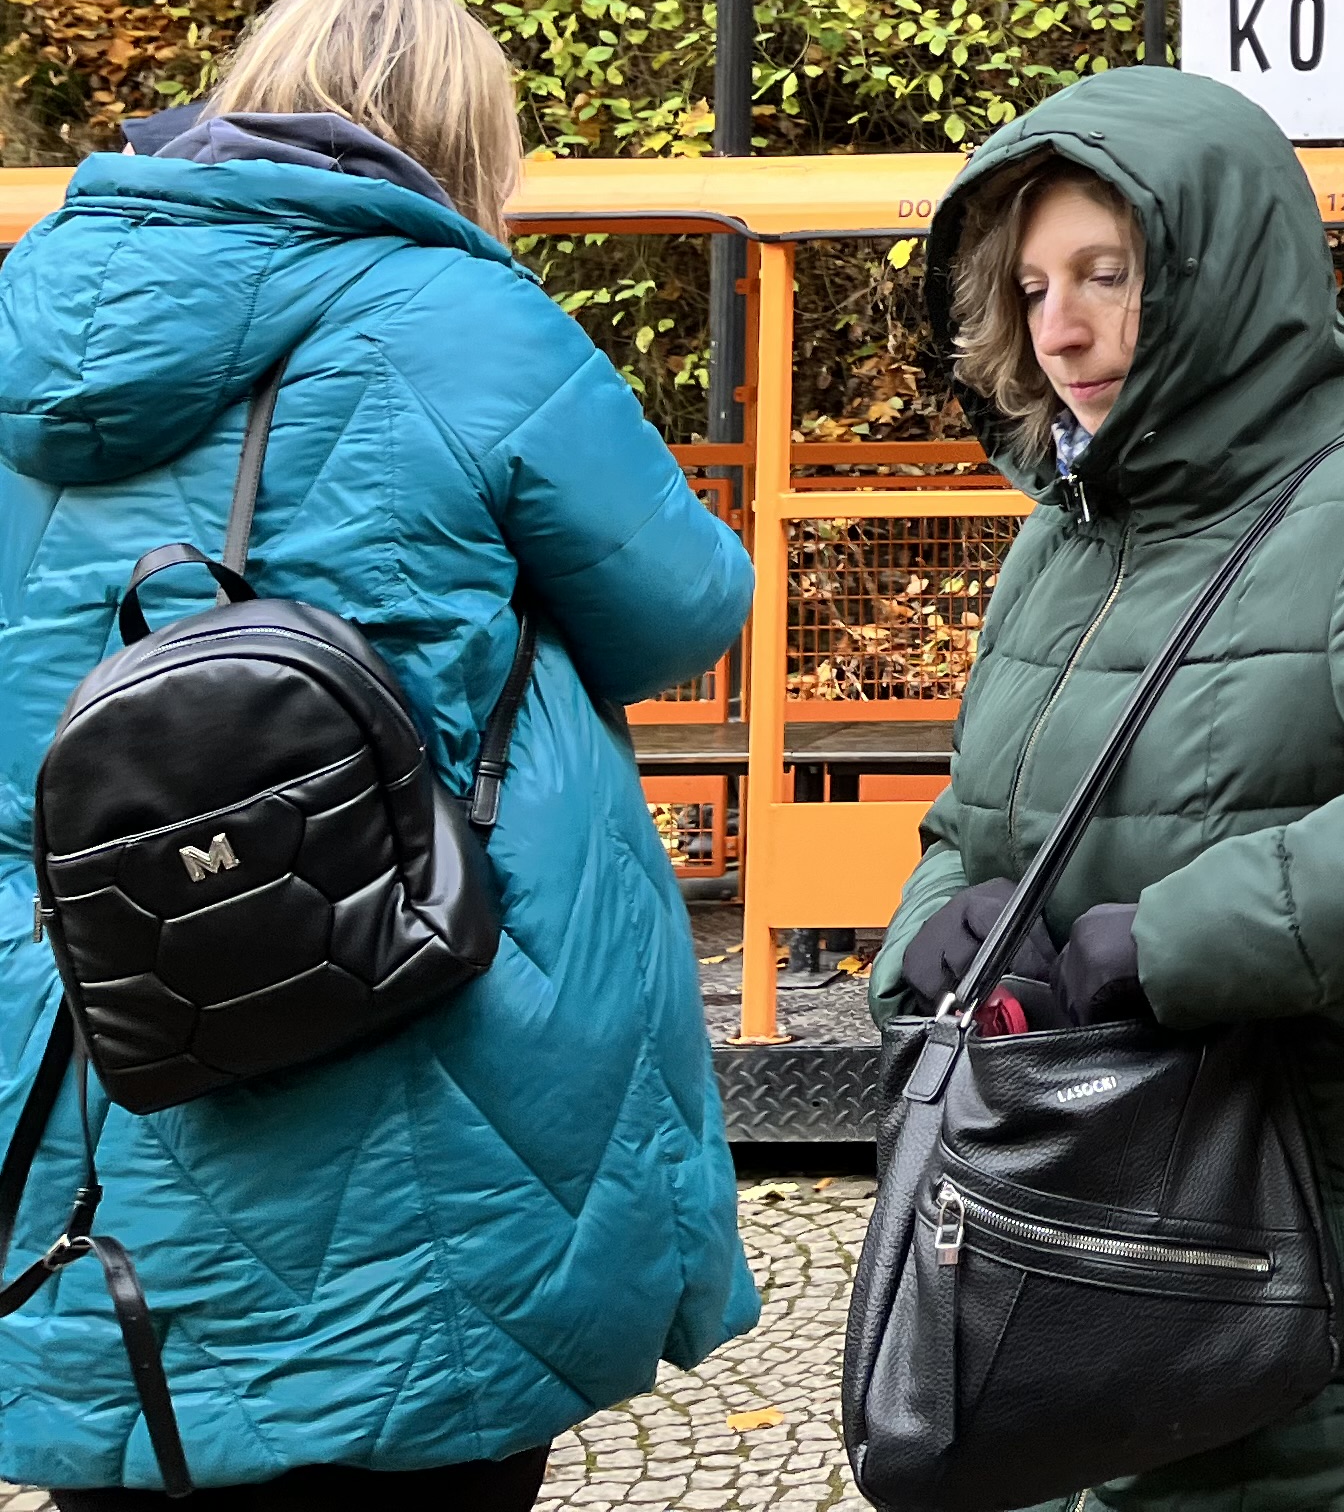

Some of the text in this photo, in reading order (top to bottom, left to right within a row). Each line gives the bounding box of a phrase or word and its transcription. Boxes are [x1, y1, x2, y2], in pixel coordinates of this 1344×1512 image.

[898, 199, 943, 219] DO
[178, 832, 241, 883] M
[1056, 1075, 1117, 1103] LASOCKI
